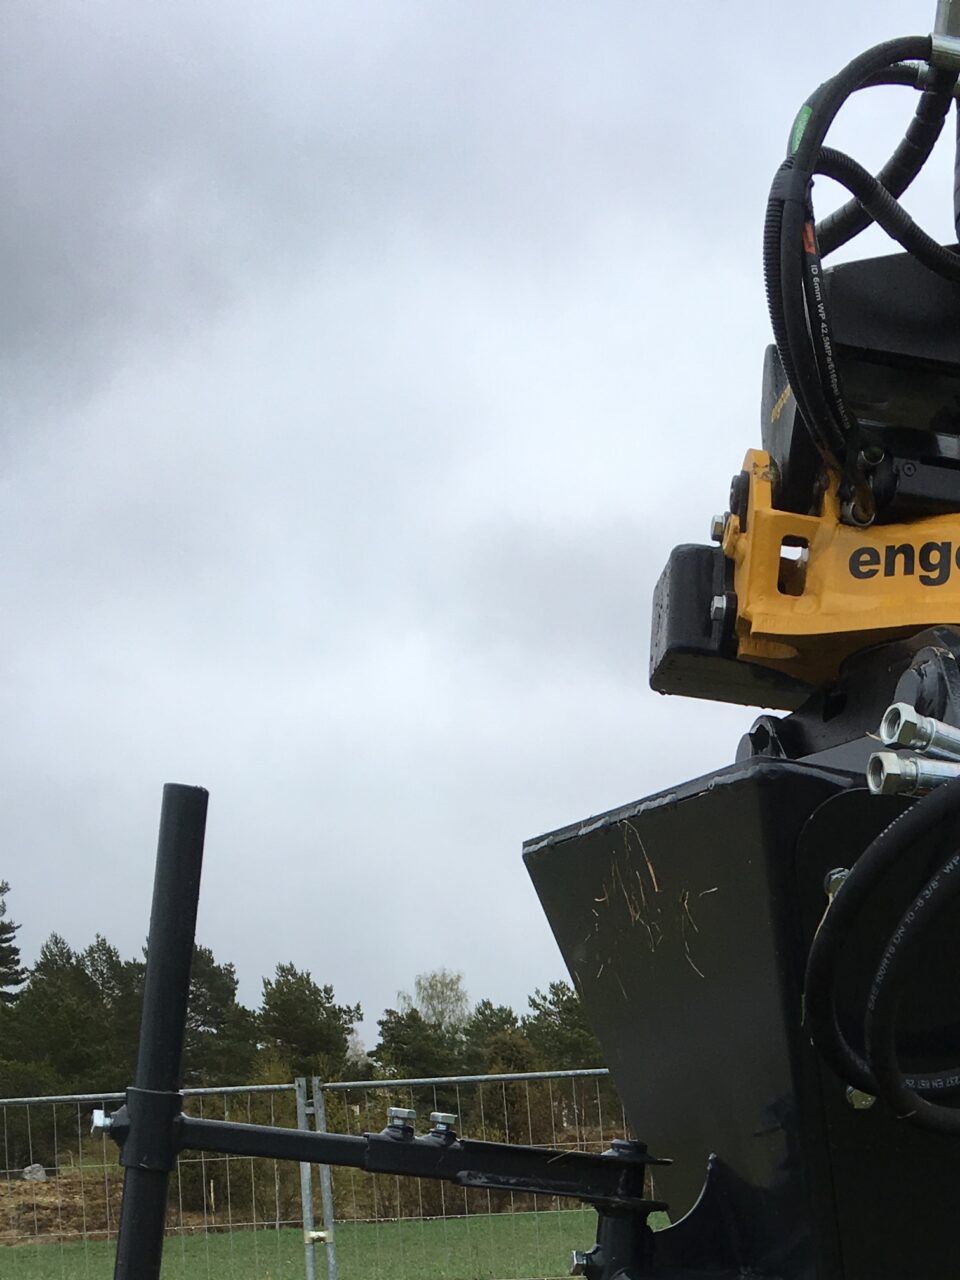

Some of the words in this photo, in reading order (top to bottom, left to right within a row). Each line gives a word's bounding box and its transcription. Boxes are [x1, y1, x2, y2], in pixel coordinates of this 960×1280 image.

[809, 264, 819, 275] ID
[811, 276, 822, 301] 6mm
[817, 302, 826, 320] WP
[893, 925, 905, 944] DN
[942, 855, 960, 874] WP
